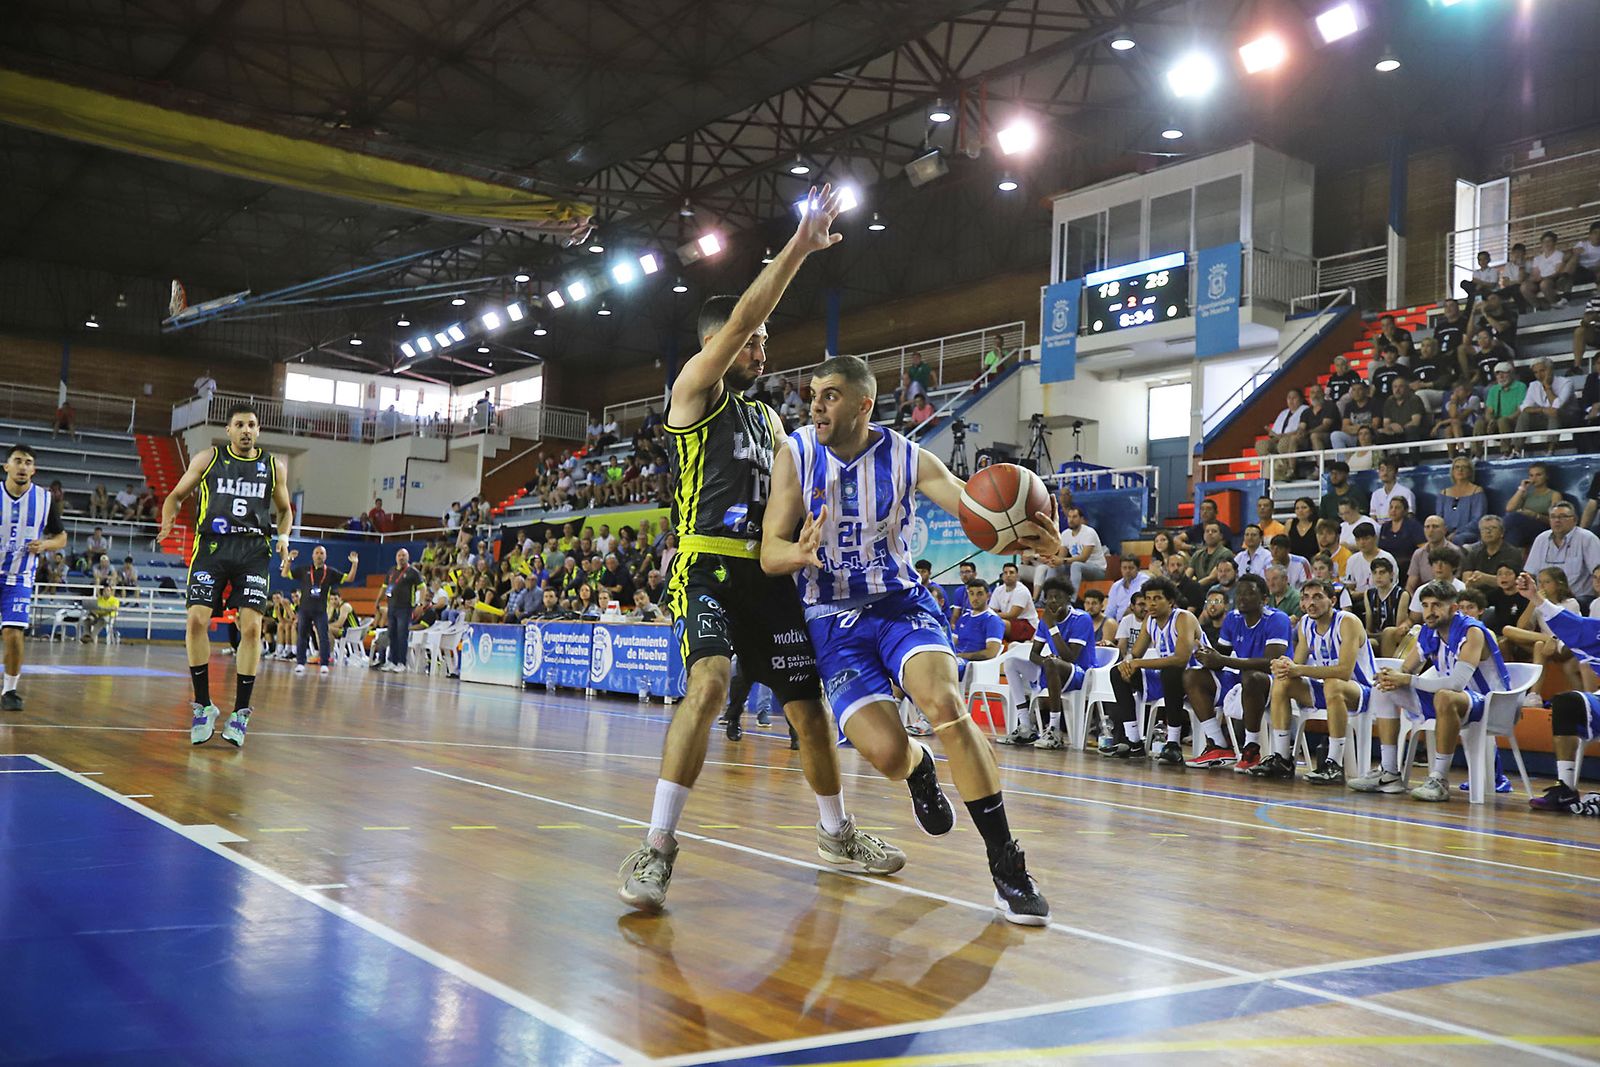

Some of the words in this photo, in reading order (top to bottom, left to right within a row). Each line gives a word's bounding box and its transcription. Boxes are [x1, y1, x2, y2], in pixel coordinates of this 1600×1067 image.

[1144, 270, 1170, 290] 25
[1127, 296, 1137, 308] 2
[232, 498, 248, 517] 6
[838, 521, 862, 548] 21
[544, 631, 590, 644] Ayuntamiento
[613, 634, 668, 648] Ayuntamiento
[555, 643, 564, 654] de
[565, 644, 589, 656] Huelva
[627, 647, 637, 660] de
[638, 648, 667, 661] Huelva
[645, 662, 668, 672] Deportes
